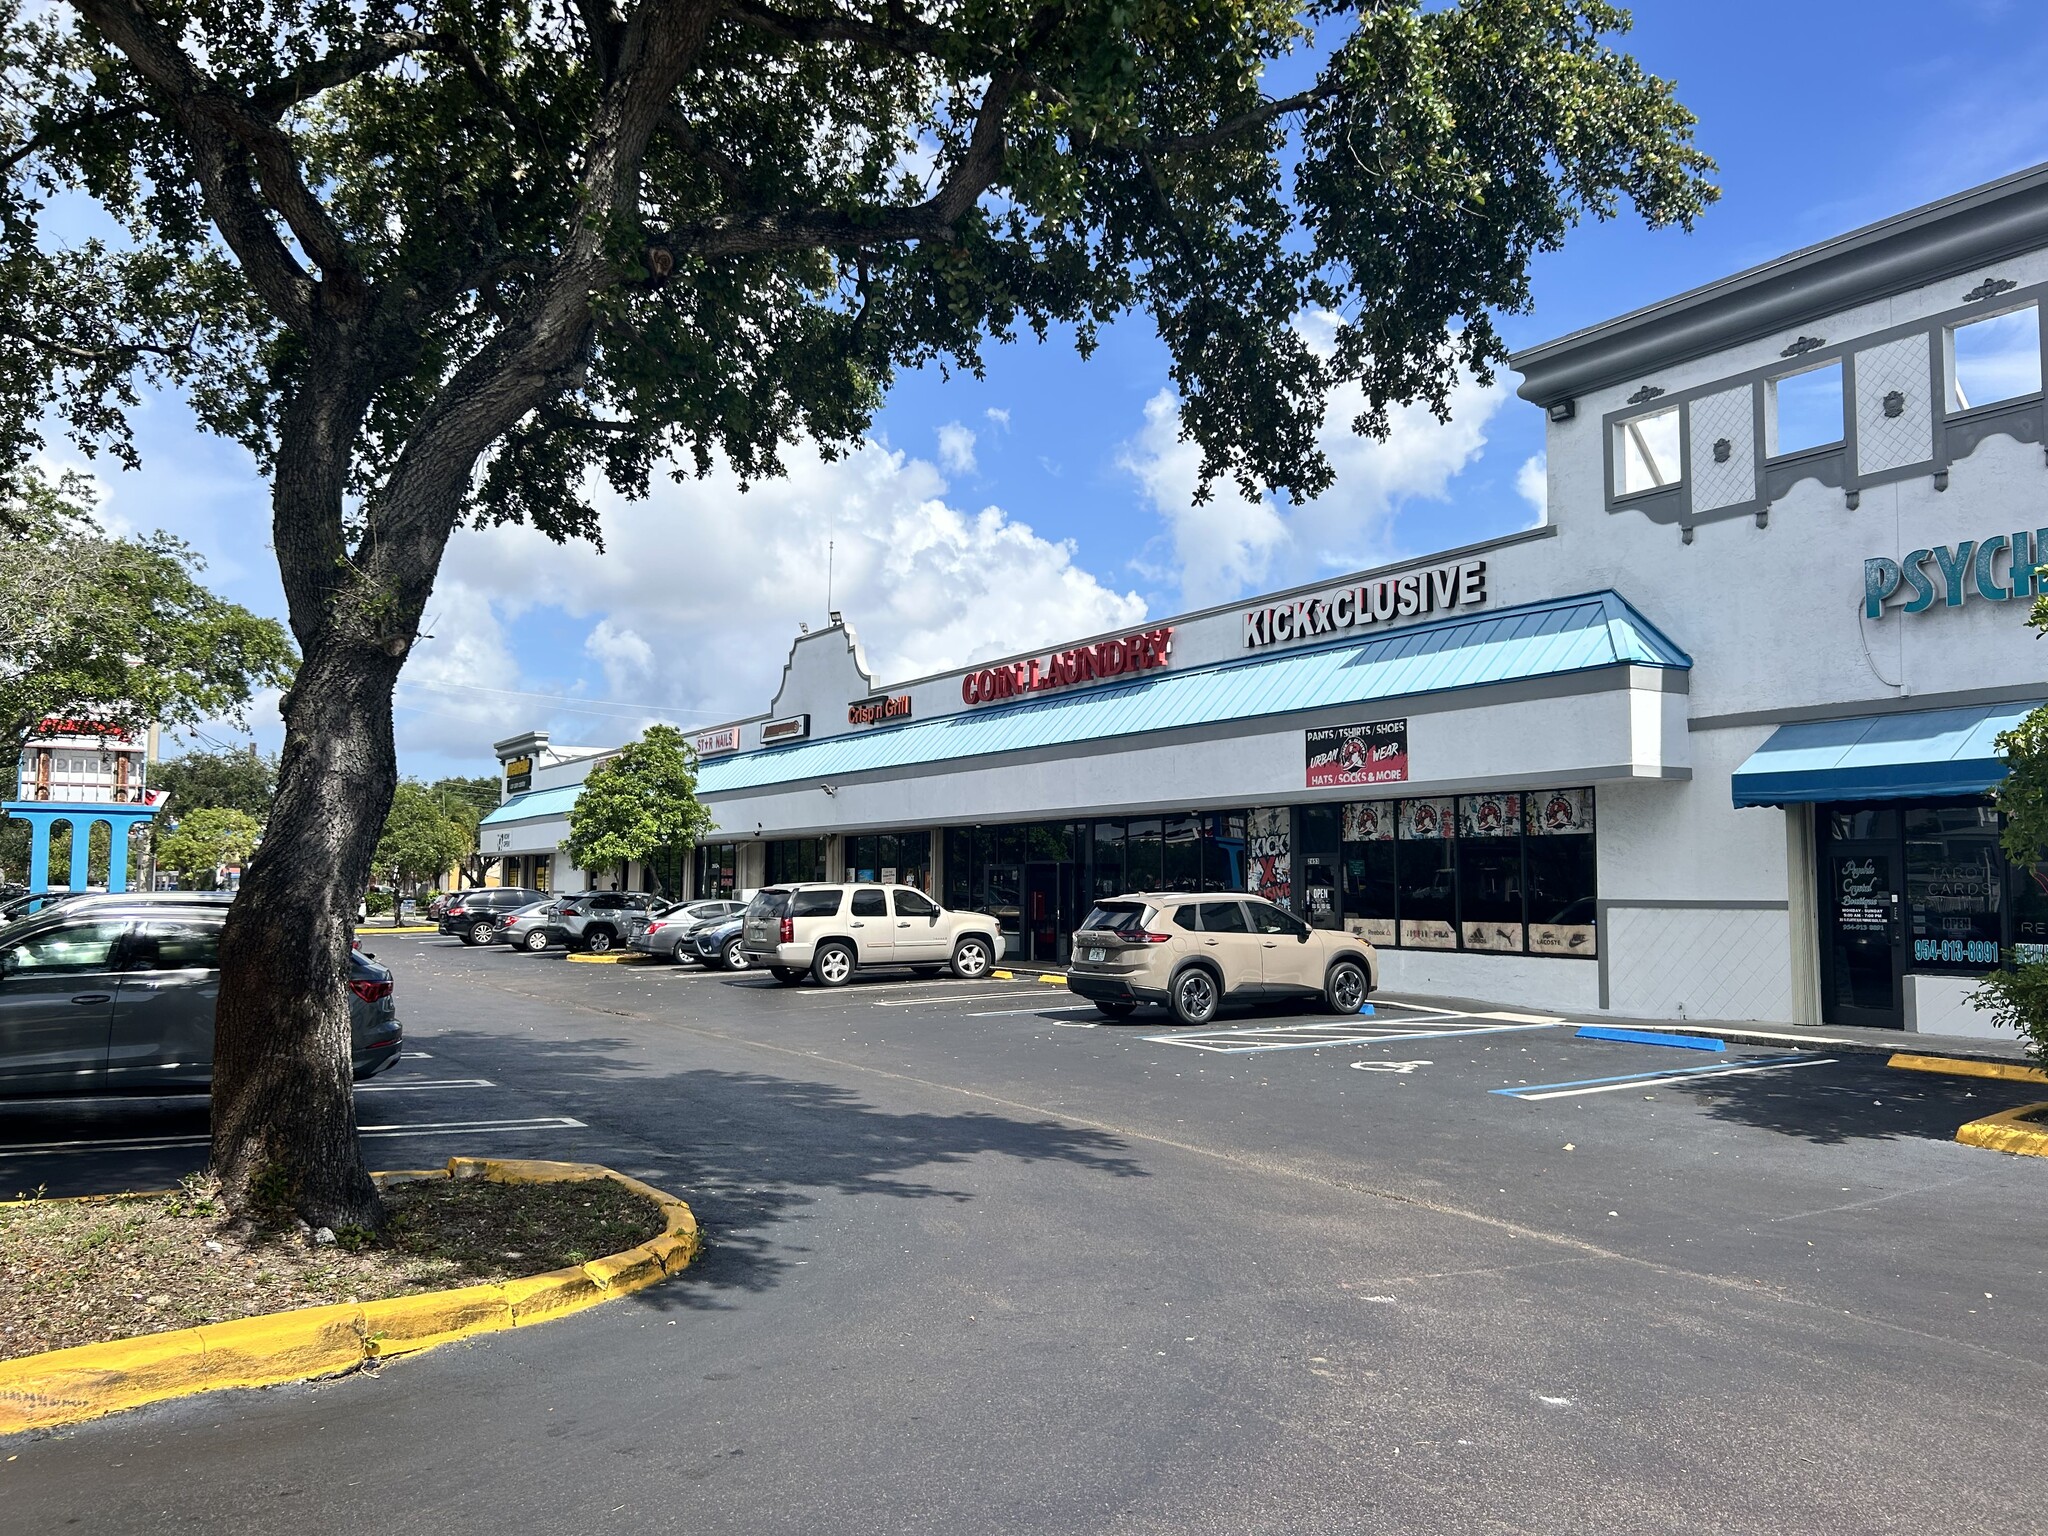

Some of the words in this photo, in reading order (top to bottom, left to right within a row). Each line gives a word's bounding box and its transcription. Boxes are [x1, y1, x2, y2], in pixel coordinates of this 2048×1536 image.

[962, 661, 1025, 705] COIN
[1027, 627, 1174, 692] LAUNDRY
[848, 704, 875, 725] Crisp
[885, 695, 909, 717] Grill
[715, 732, 733, 748] NAILS
[1307, 730, 1333, 741] PANTS
[1339, 725, 1371, 738] TSHIRTS
[1376, 722, 1404, 734] SHOES
[1310, 747, 1339, 769] URBAN
[1372, 742, 1399, 762] WEAR
[1311, 774, 1333, 786] HATS
[1338, 771, 1366, 783] SOCKS
[1367, 771, 1375, 782] &
[1376, 769, 1402, 780] MORE
[1251, 834, 1288, 858] KICK
[1259, 856, 1277, 886] X
[1931, 866, 1991, 879] TAROT
[1313, 888, 1328, 899] OPEN
[1928, 882, 1991, 896] CARDS
[1433, 930, 1449, 938] FILA
[1914, 939, 1999, 963] 954-913-8891
